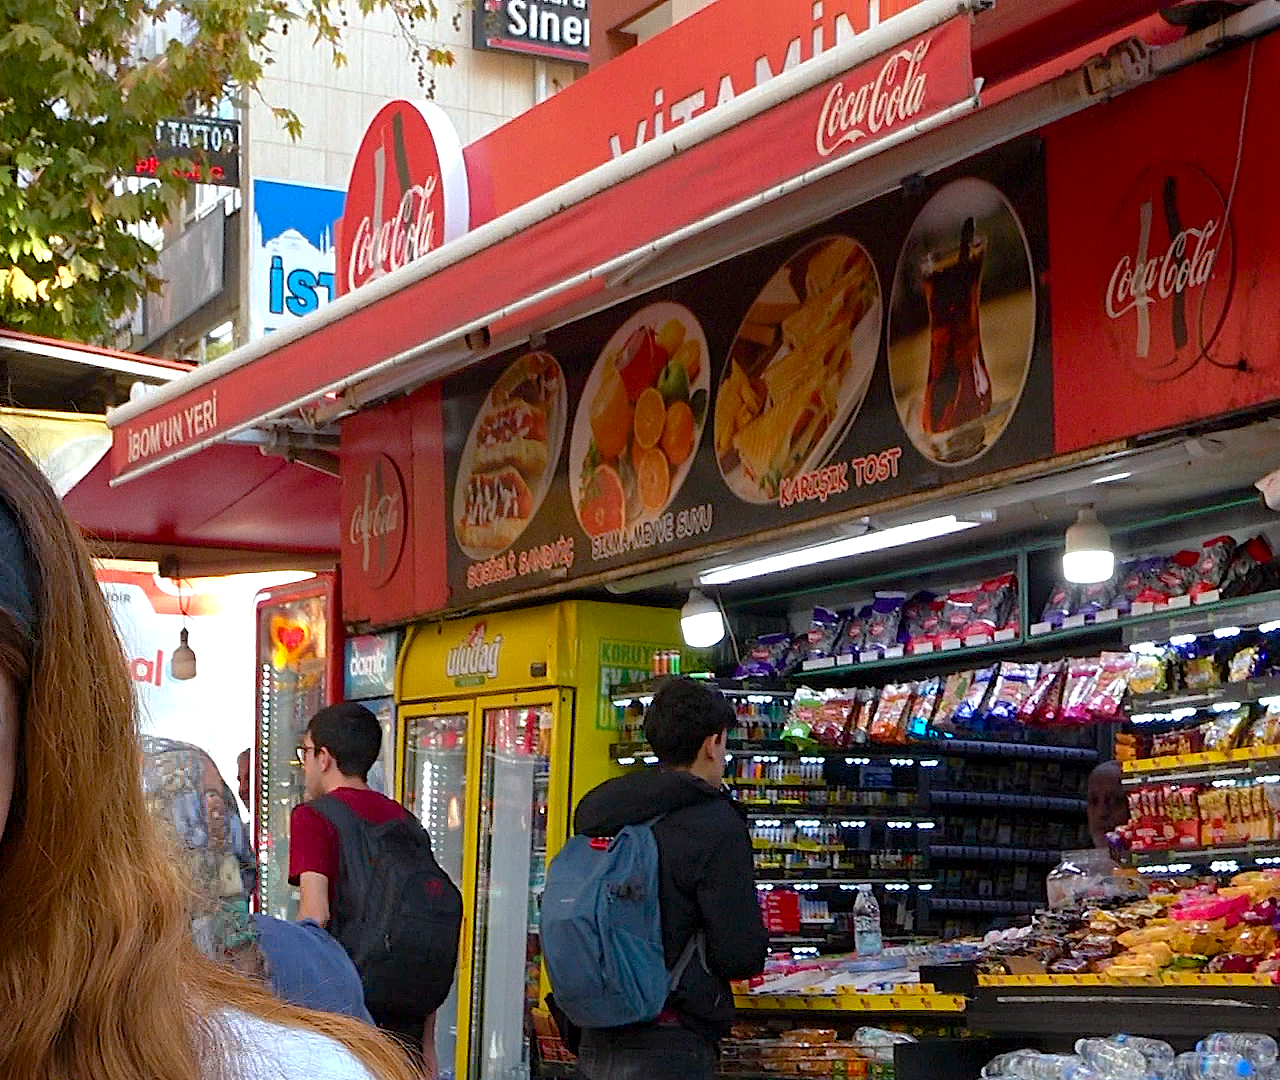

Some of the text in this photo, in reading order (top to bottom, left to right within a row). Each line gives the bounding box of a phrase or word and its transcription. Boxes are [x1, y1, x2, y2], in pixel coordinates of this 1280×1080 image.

[816, 37, 932, 156] Coca-Cola
[348, 175, 438, 294] Coca-Cola
[1106, 217, 1220, 318] Coca-Cola
[185, 389, 217, 438] YERİ
[852, 447, 902, 487] TOST
